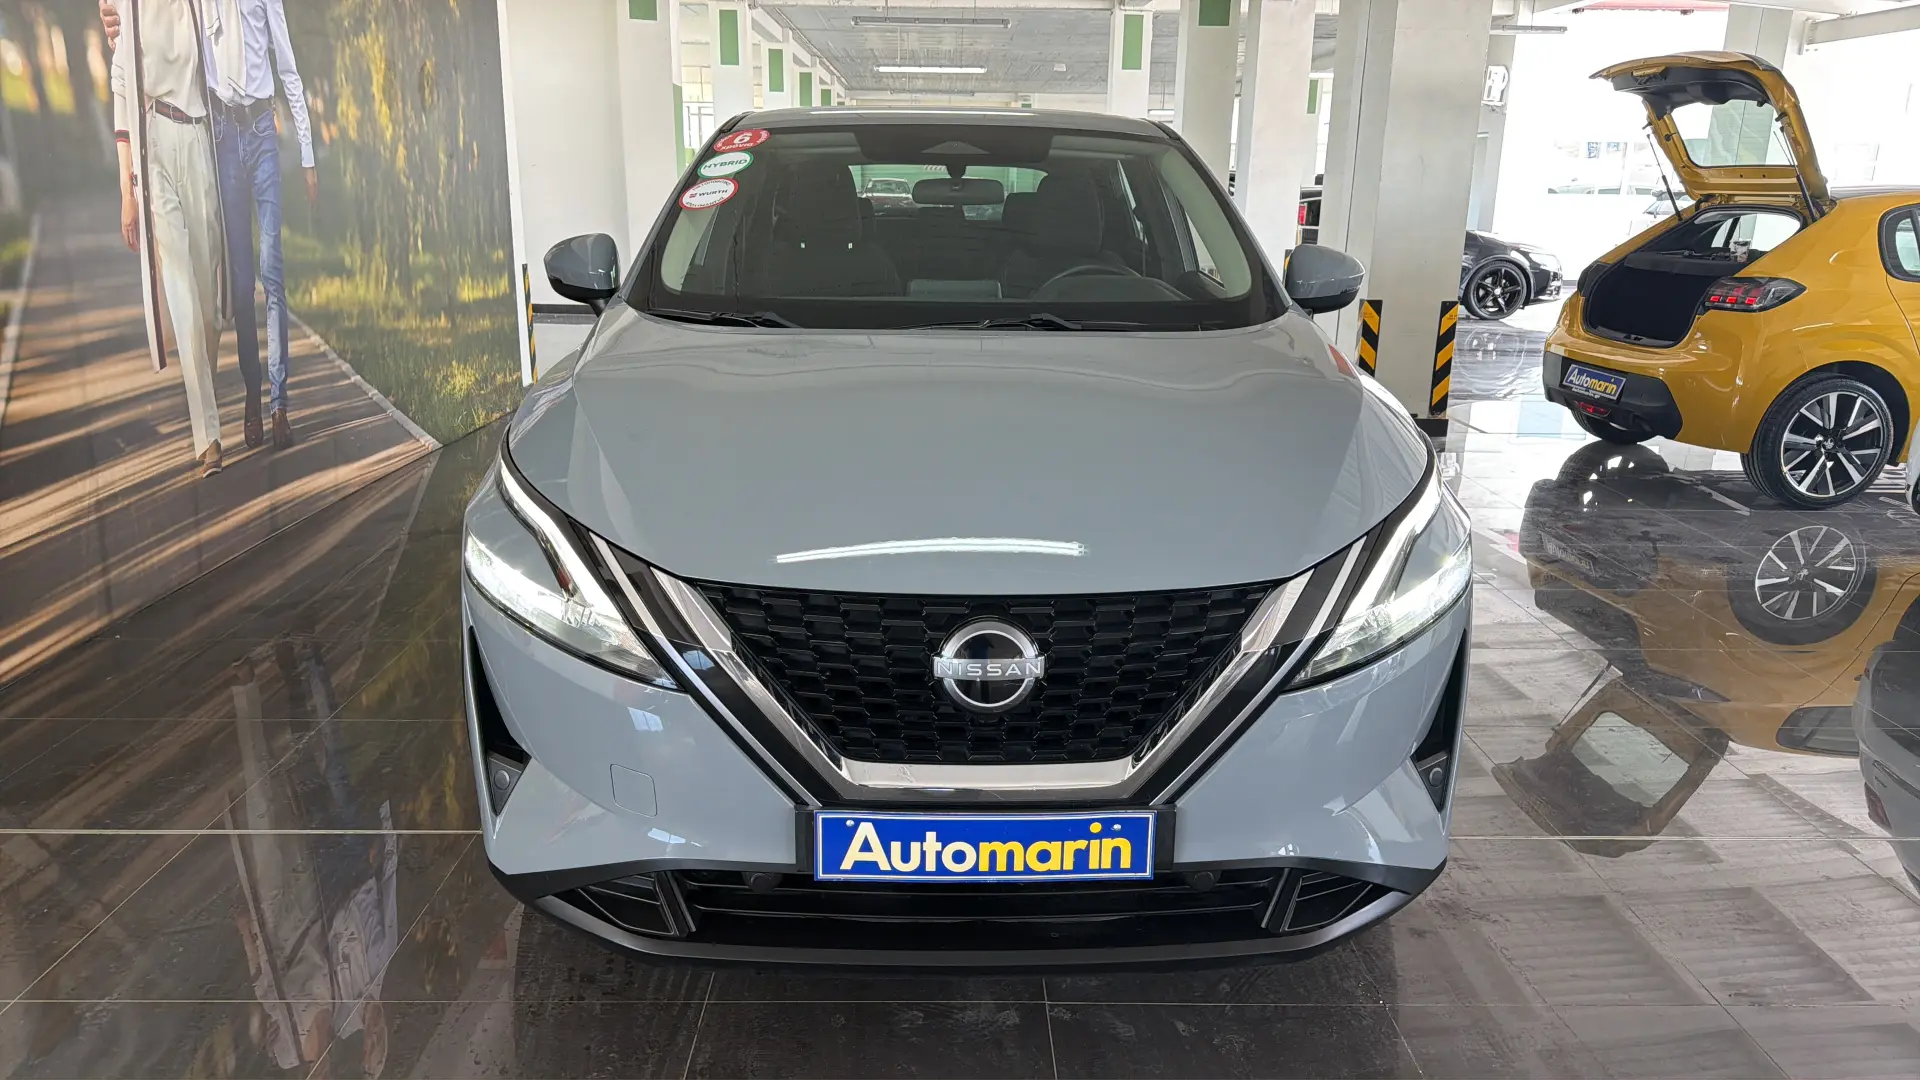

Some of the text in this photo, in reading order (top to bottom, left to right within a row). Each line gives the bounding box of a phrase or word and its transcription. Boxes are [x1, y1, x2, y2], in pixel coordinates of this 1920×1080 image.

[733, 134, 752, 144] 6
[703, 159, 747, 169] HYBRID
[1567, 368, 1617, 395] Automarin
[937, 663, 1040, 676] NISSAN
[839, 821, 1131, 872] Automarin
